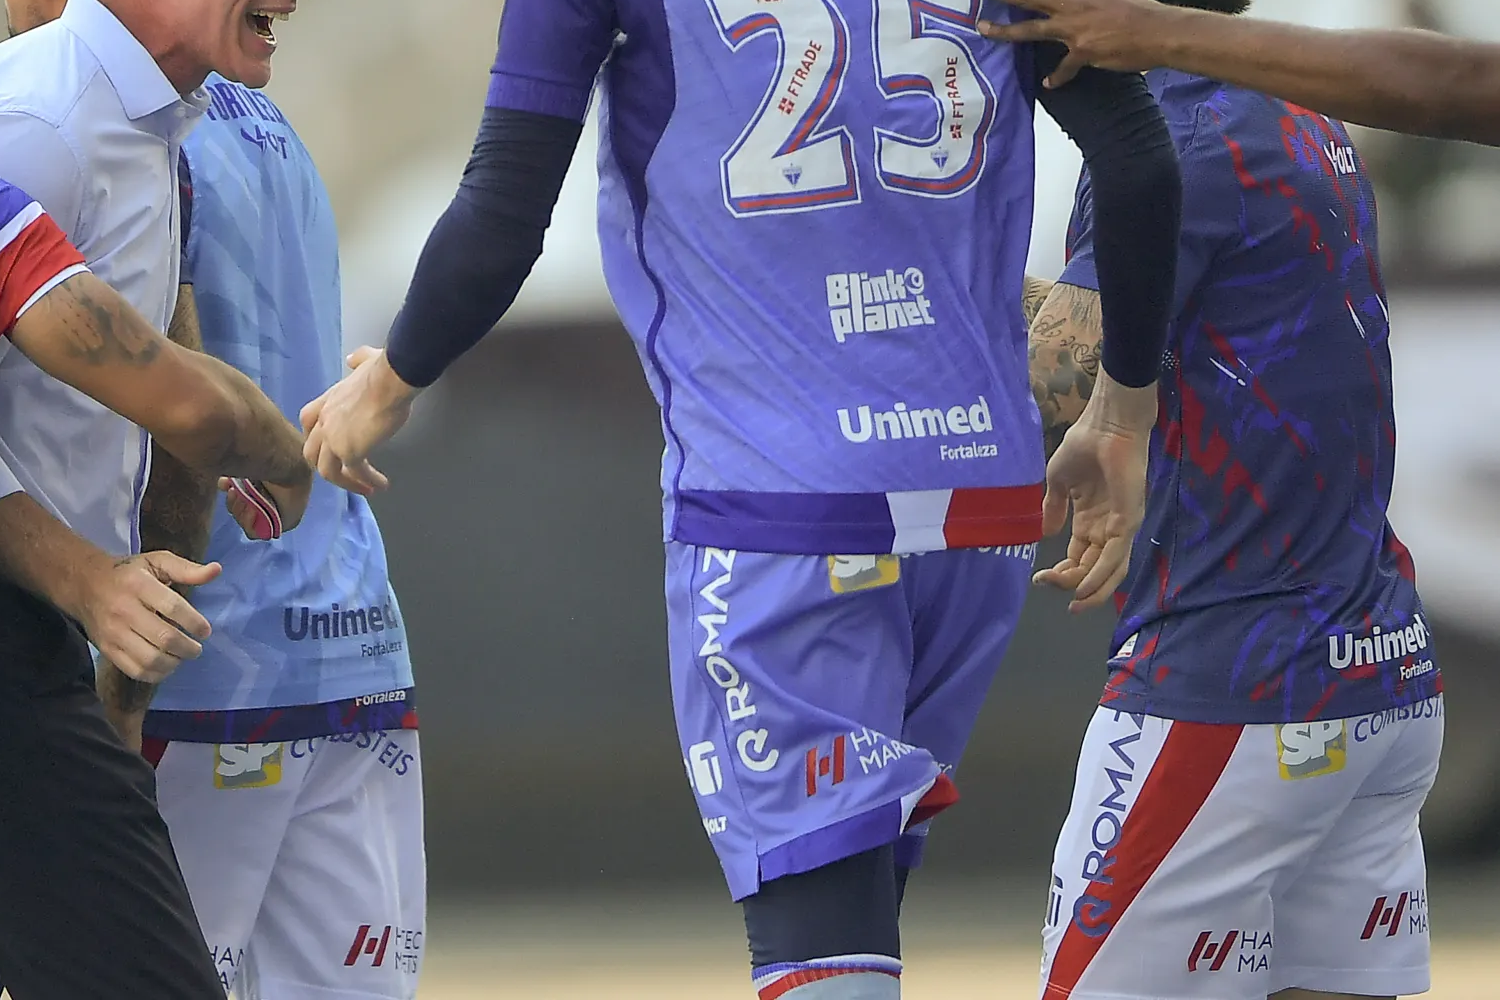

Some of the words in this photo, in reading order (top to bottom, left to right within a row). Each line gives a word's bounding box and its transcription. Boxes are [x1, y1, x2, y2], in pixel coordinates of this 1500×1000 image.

[787, 39, 823, 98] FTRADE
[945, 55, 965, 119] FTRADE
[1323, 140, 1357, 178] VOLT
[825, 268, 907, 307] Blink
[829, 294, 936, 343] planet
[836, 395, 993, 443] Unimed
[939, 441, 999, 462] Fortaleza
[283, 594, 399, 642] Unimed
[1328, 612, 1430, 670] Unimed
[360, 640, 403, 658] Fortaleza
[355, 689, 407, 707] Fortaleza
